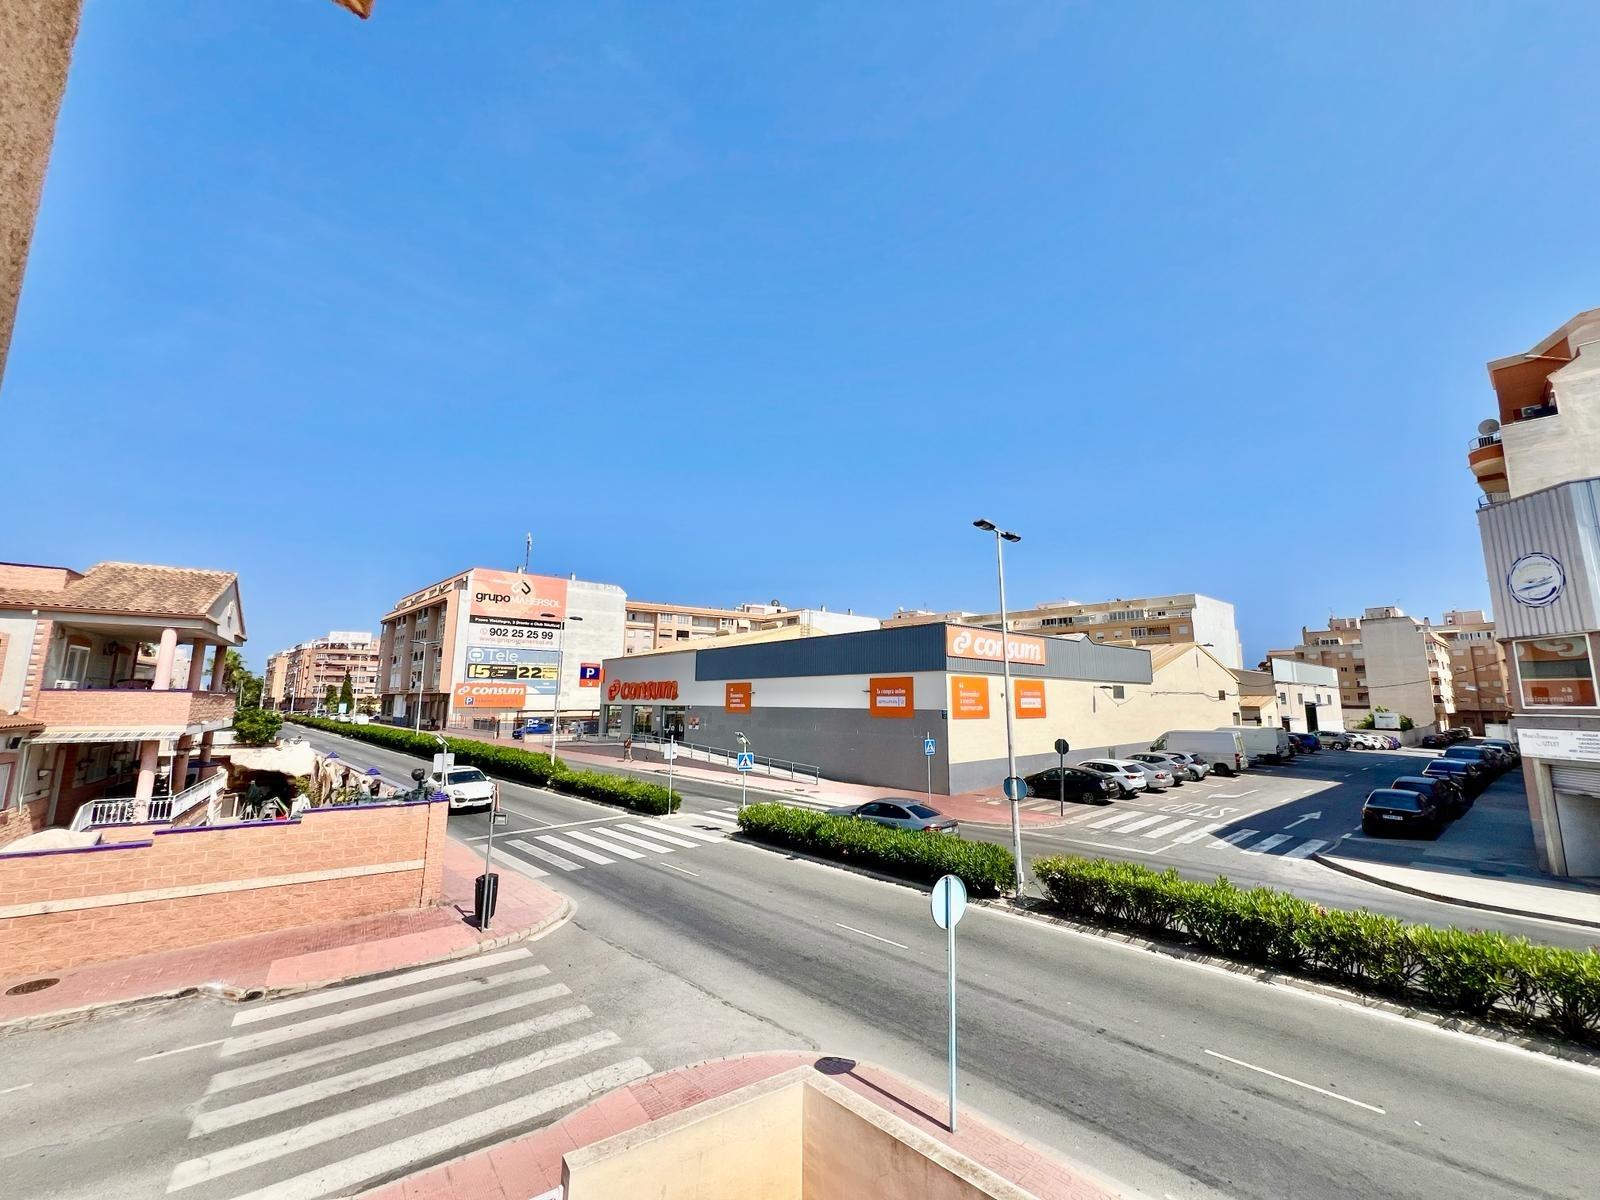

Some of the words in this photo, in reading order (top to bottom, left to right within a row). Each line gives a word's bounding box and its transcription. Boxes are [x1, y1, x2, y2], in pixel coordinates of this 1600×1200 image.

[475, 592, 511, 603] grupo
[489, 627, 509, 637] 902
[511, 629, 524, 638] 25
[526, 630, 539, 639] 25
[541, 631, 554, 640] 99
[973, 637, 1042, 660] consum
[486, 649, 518, 661] Tele
[469, 665, 490, 678] 15
[518, 667, 542, 678] 22
[586, 668, 595, 678] P
[471, 686, 525, 696] consum
[620, 680, 679, 700] consum
[1158, 802, 1240, 819] STOP
